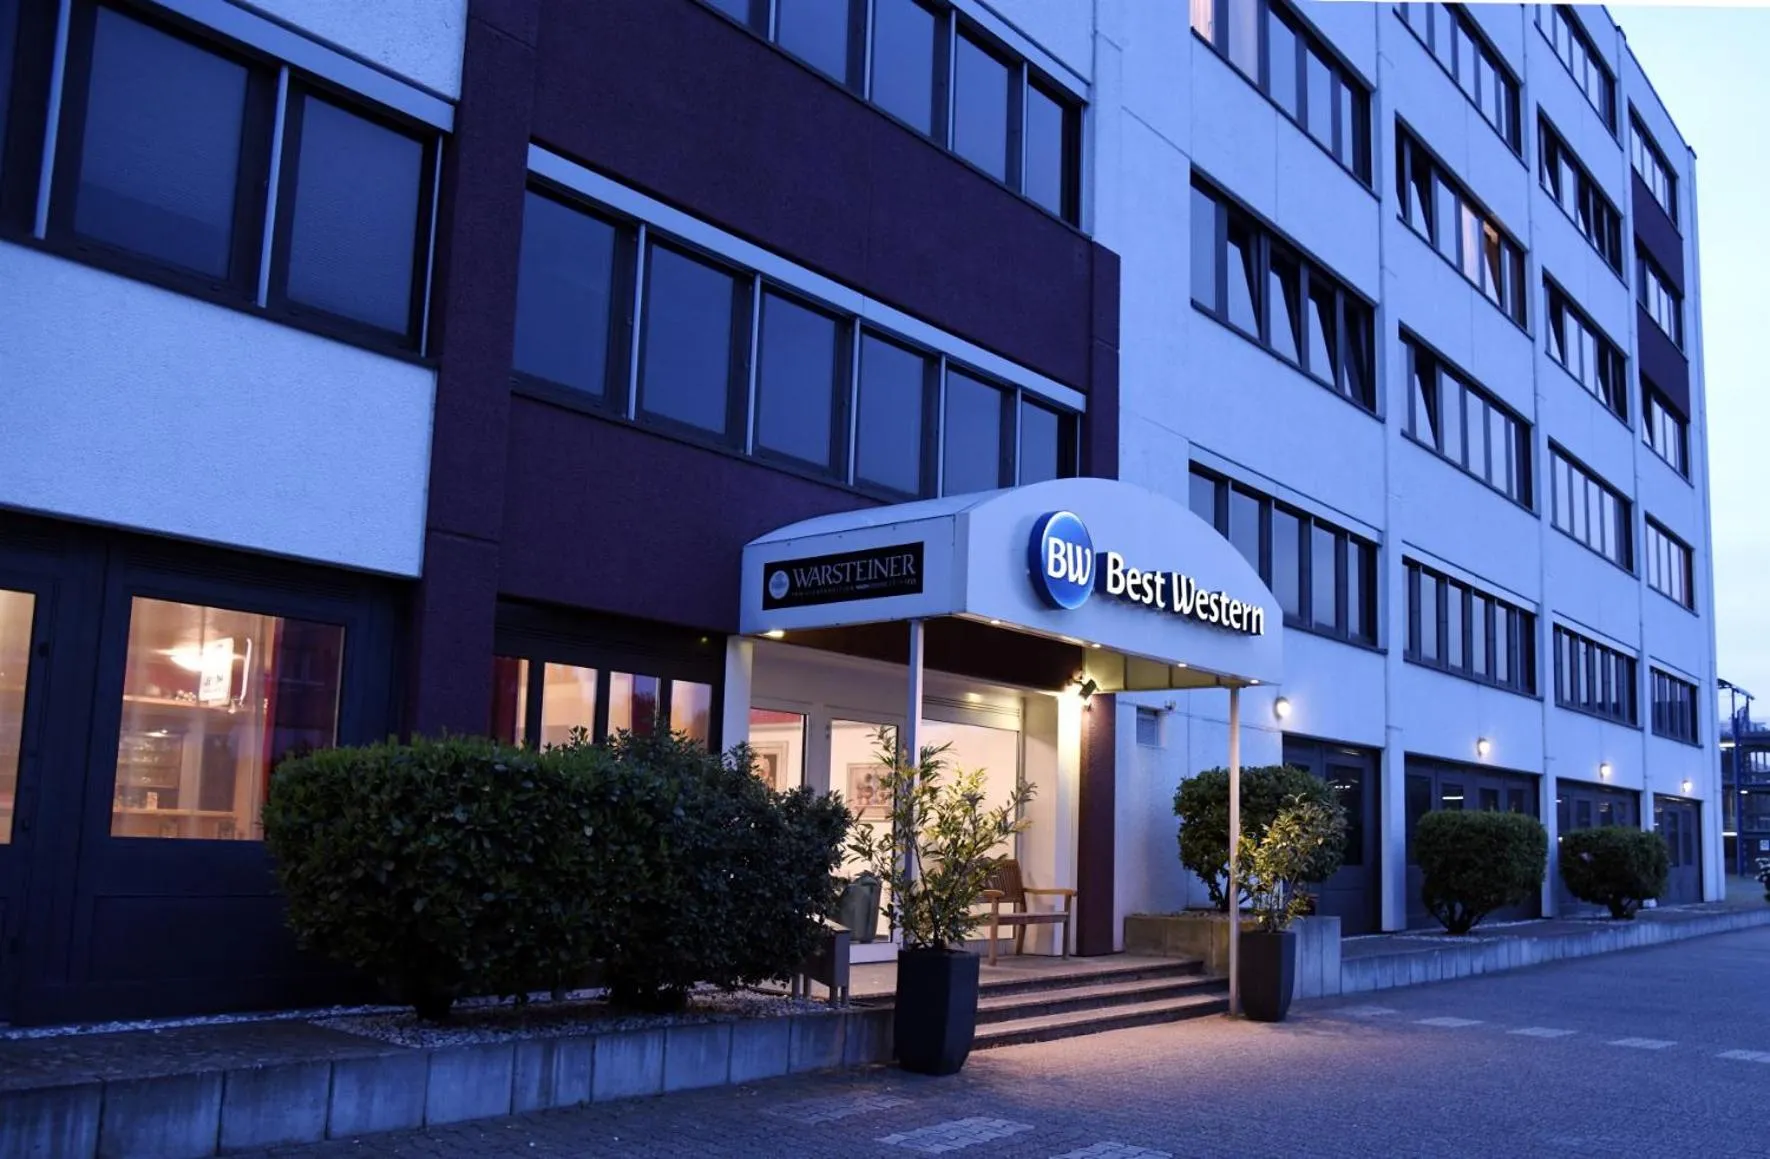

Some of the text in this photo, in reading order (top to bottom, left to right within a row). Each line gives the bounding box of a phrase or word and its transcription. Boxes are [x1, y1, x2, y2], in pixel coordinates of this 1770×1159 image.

[791, 553, 917, 588] WARSTEINER
[1047, 537, 1092, 586] BW
[1106, 551, 1265, 635] Best Western
